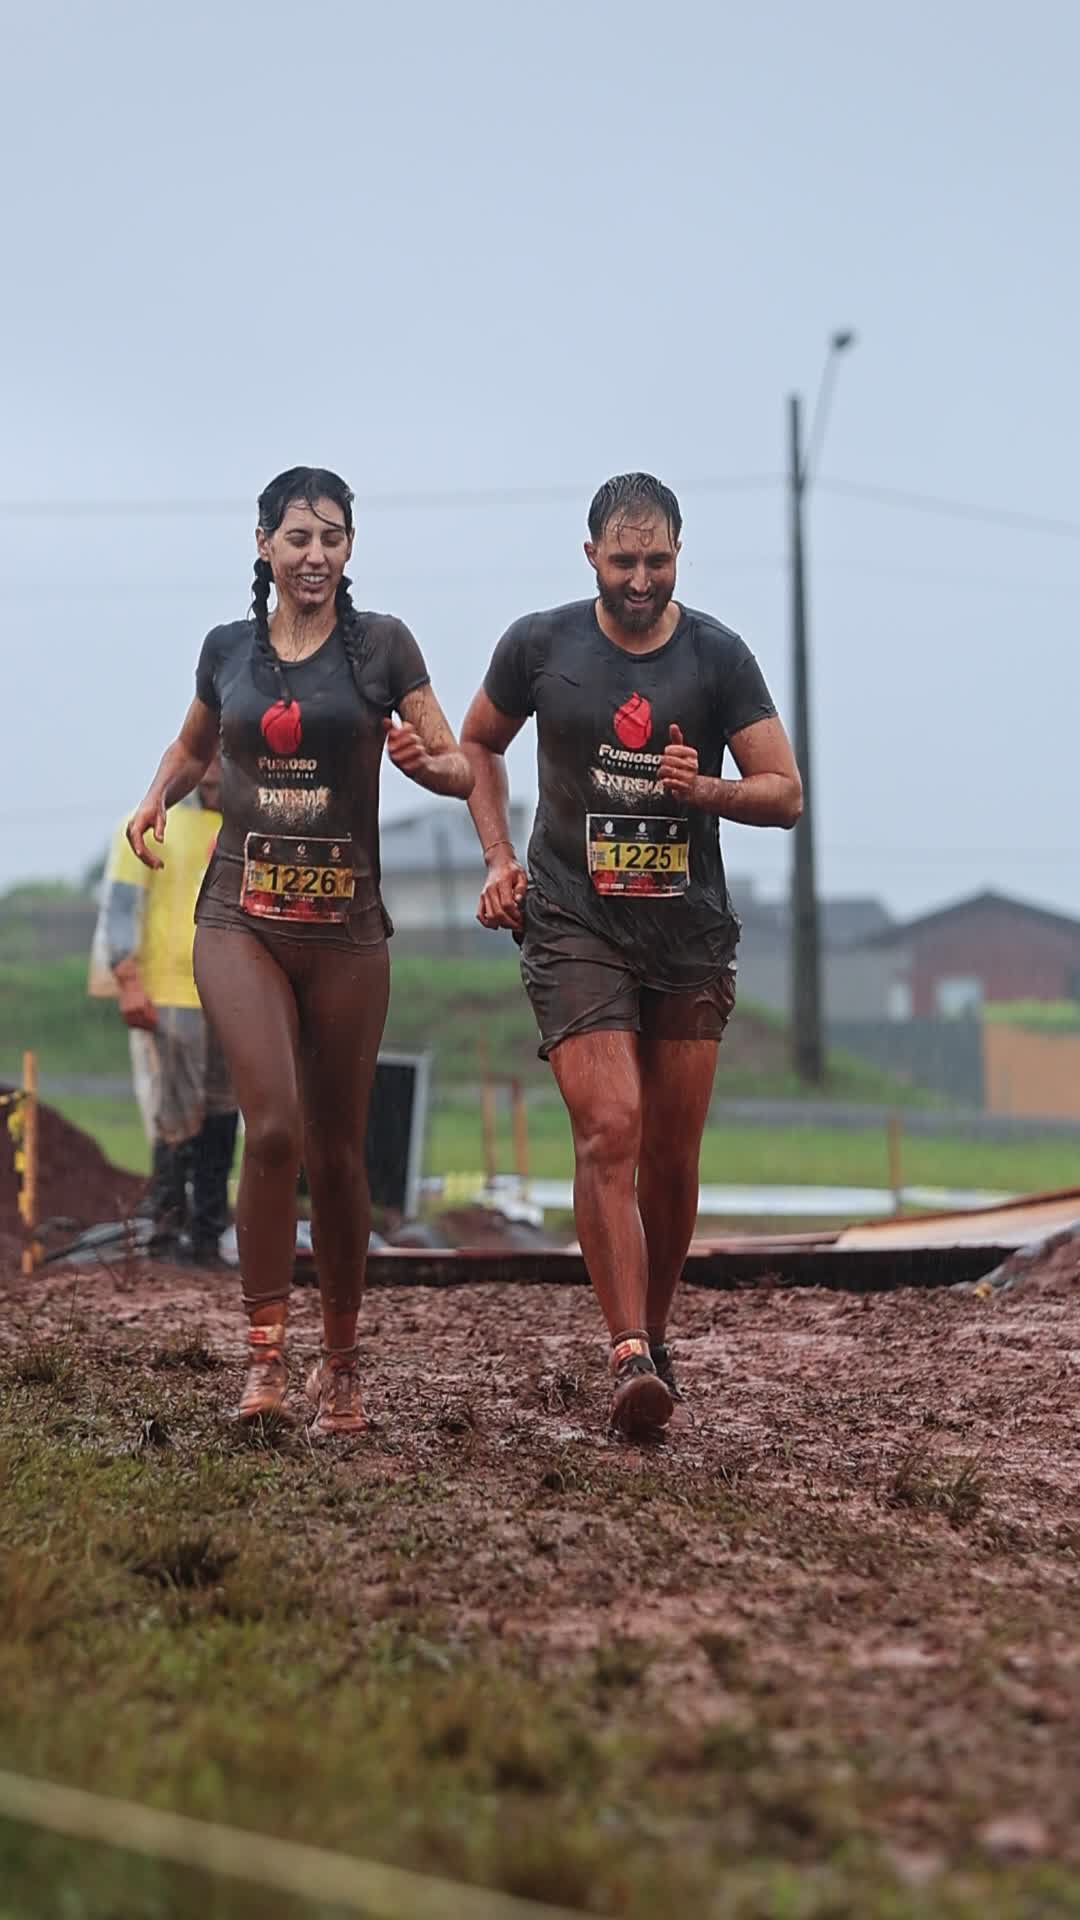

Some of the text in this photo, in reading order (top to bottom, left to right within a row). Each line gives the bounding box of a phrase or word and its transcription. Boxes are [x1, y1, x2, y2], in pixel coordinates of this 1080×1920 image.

[599, 744, 662, 765] FURIOSO
[609, 844, 671, 869] 1225
[267, 866, 336, 895] 1226
